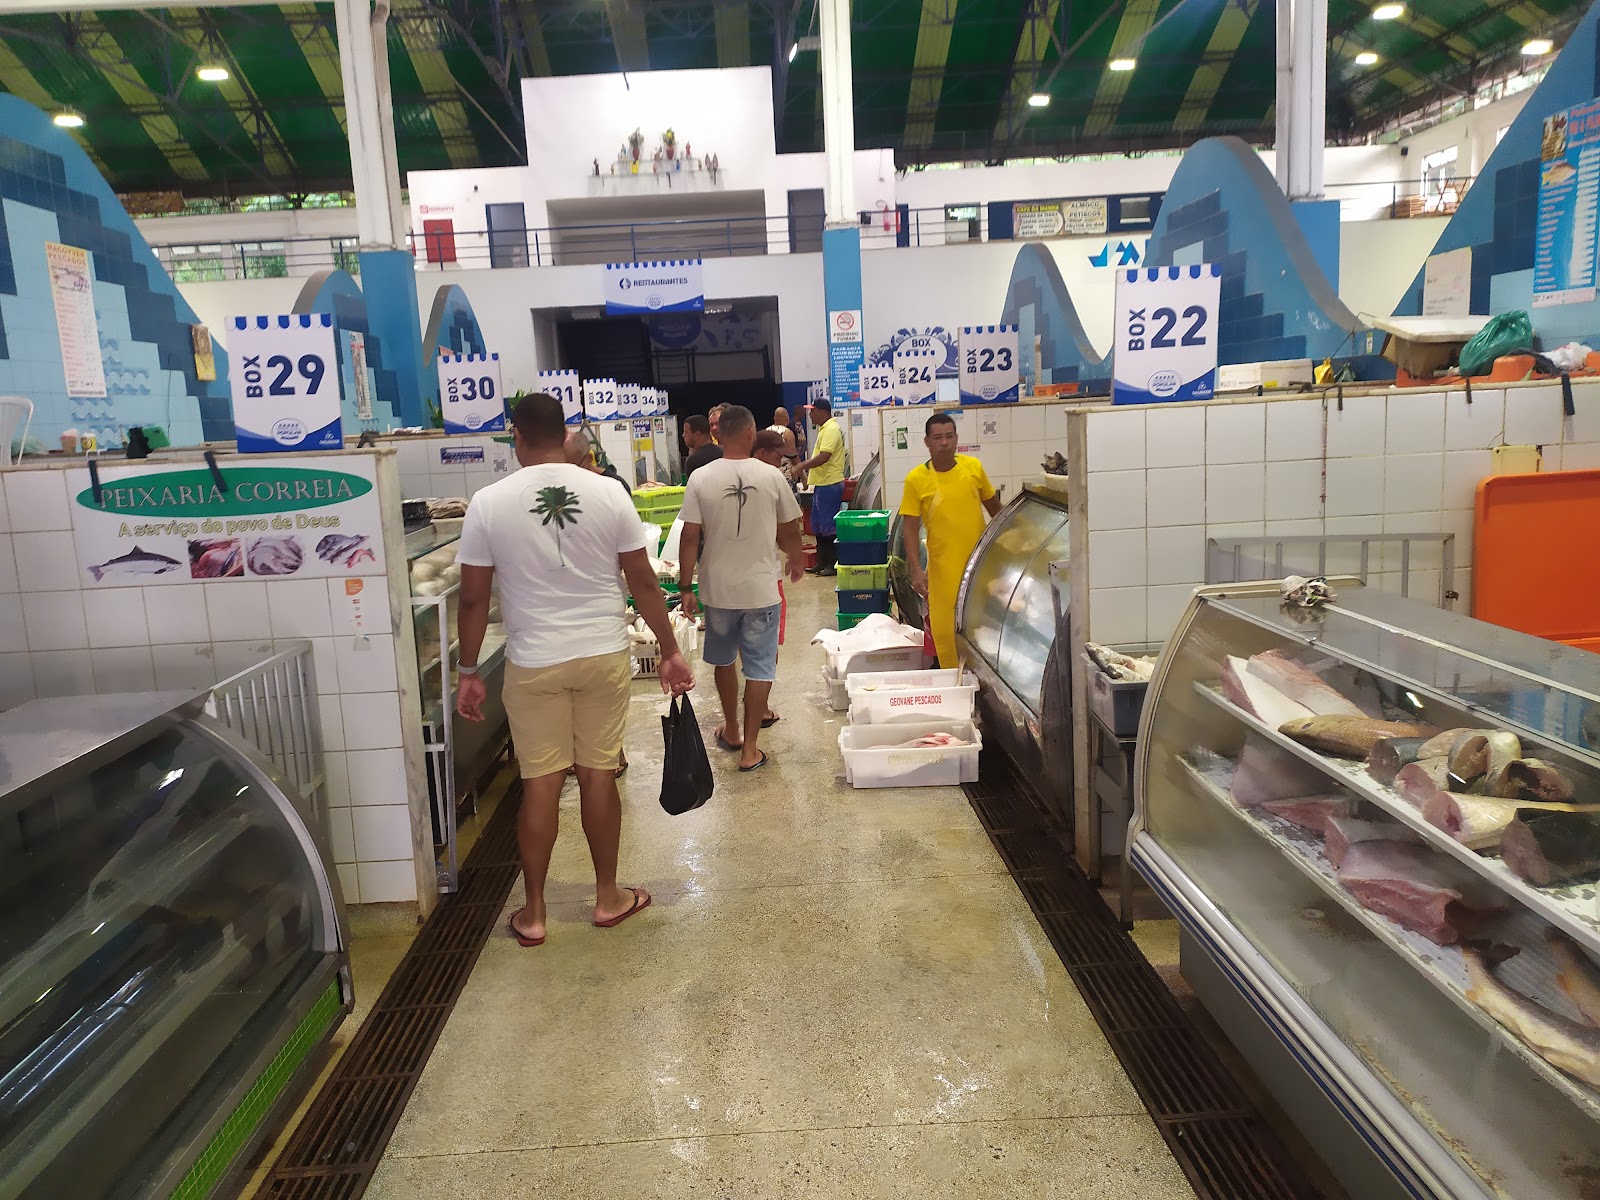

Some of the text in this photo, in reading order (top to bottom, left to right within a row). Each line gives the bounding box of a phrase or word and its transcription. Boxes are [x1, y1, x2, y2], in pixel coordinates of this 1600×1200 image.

[633, 277, 688, 287] RESTAURANTES
[1128, 305, 1208, 351] BOX 22
[911, 338, 932, 348] BOX
[966, 347, 1014, 374] BOX 23
[242, 354, 263, 398] BOX
[266, 354, 325, 397] 29
[870, 376, 889, 390] 25
[898, 366, 932, 385] BOX 24
[447, 375, 496, 403] BOX 30
[595, 390, 614, 404] 32
[623, 393, 638, 405] 33
[641, 395, 655, 405] 34
[100, 478, 354, 509] PEIXARIA CORREIA
[118, 513, 341, 538] A serviço do povo de Deus
[889, 694, 942, 706] GEOVANE PESCADOS
